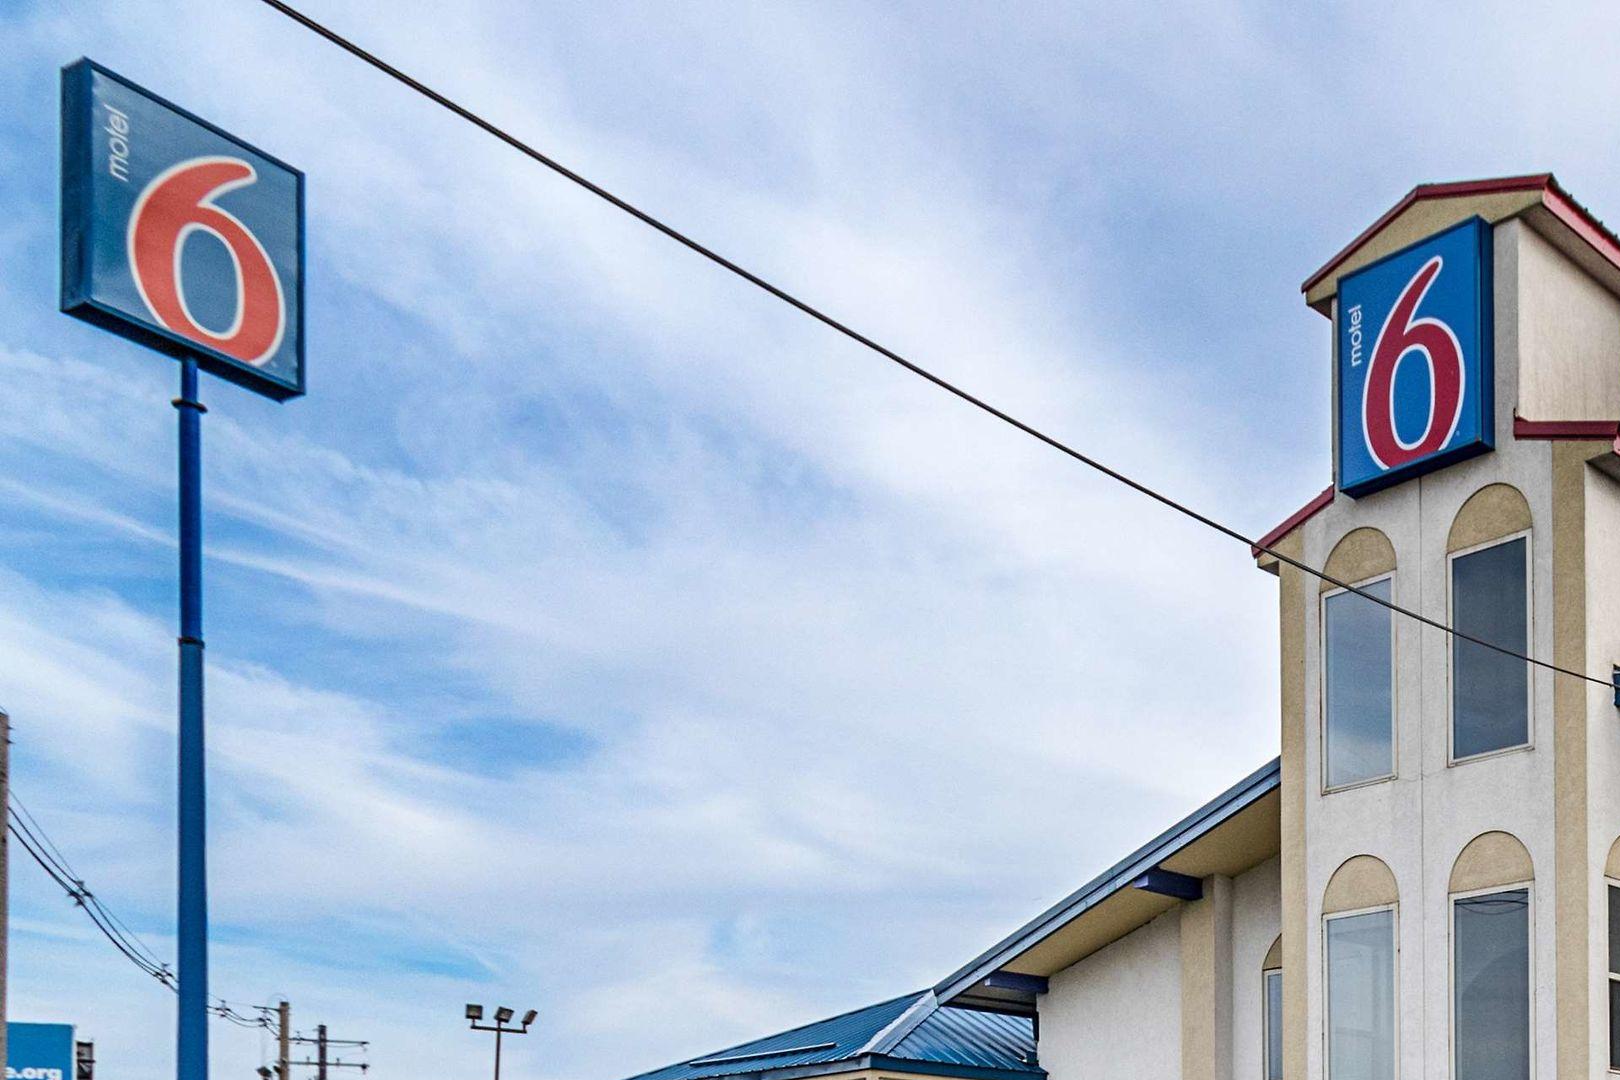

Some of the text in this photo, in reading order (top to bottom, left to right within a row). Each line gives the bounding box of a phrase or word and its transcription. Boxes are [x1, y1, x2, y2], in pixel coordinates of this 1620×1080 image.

[108, 104, 287, 367] motel 6
[1350, 254, 1466, 470] motel 6
